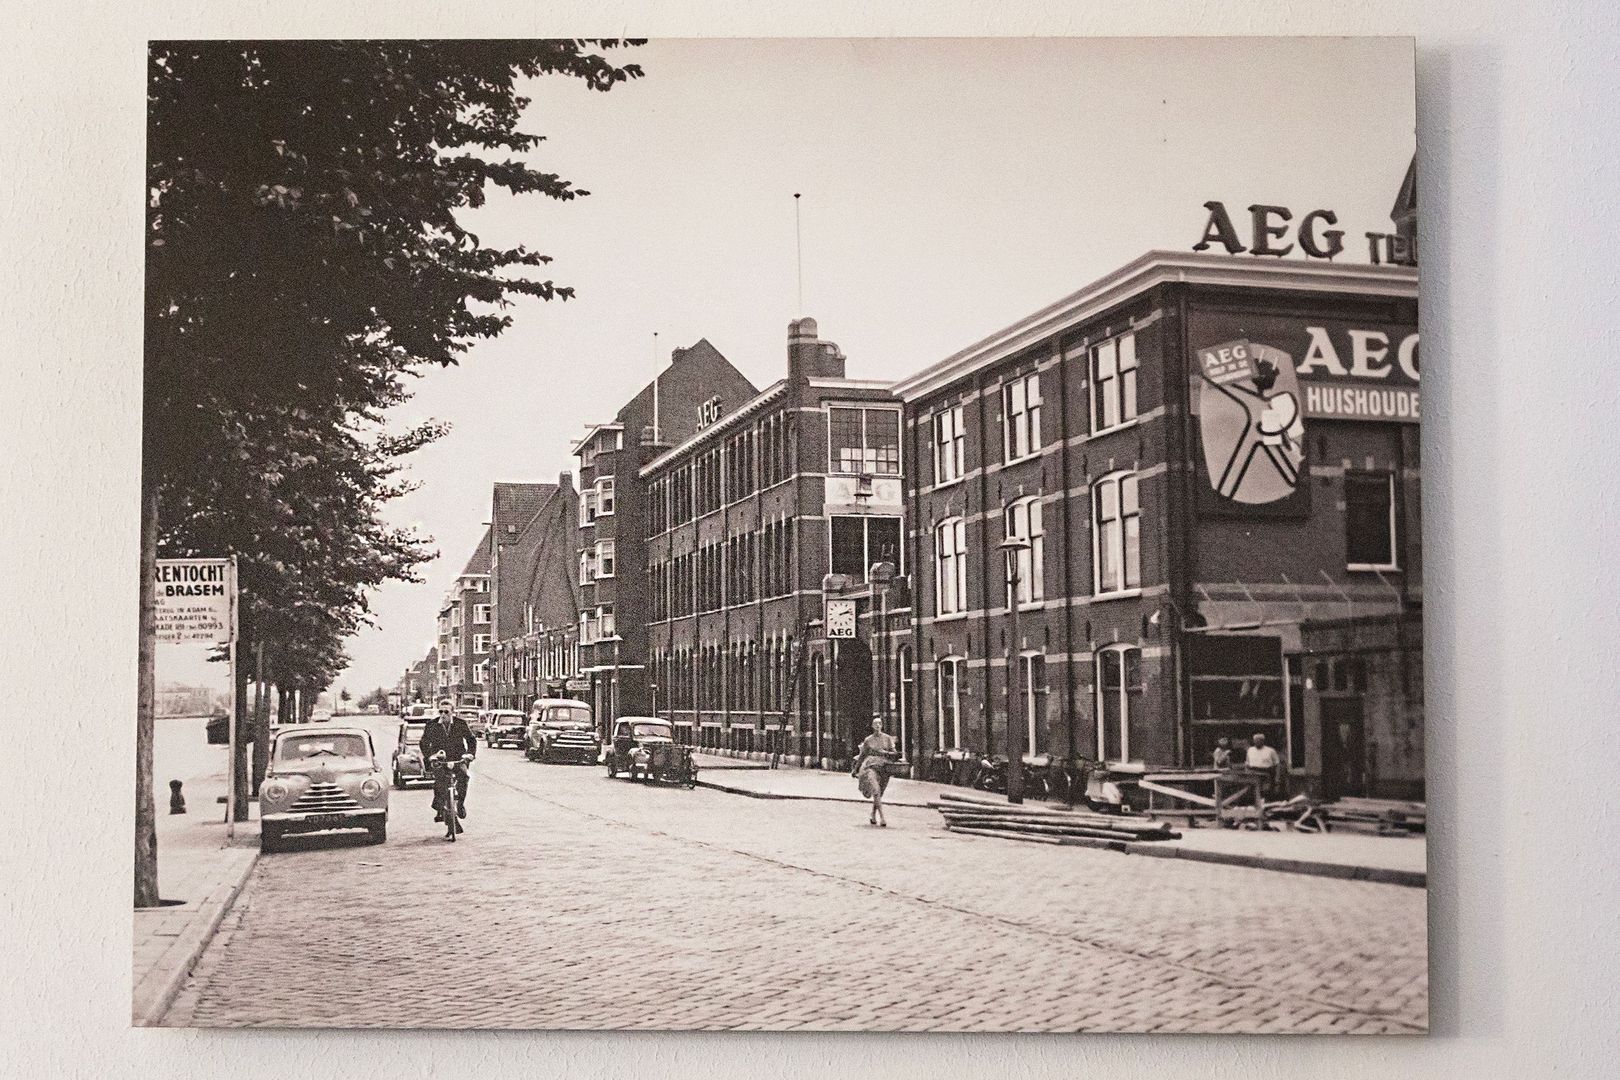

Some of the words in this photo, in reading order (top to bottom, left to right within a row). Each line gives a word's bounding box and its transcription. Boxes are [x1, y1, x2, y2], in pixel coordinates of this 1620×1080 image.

[1192, 200, 1346, 259] AEG
[1205, 345, 1247, 367] AEG
[697, 395, 722, 432] AEG
[1307, 386, 1420, 418] HUISHOUDE
[166, 585, 224, 596] BRASEM
[829, 628, 852, 636] AEG
